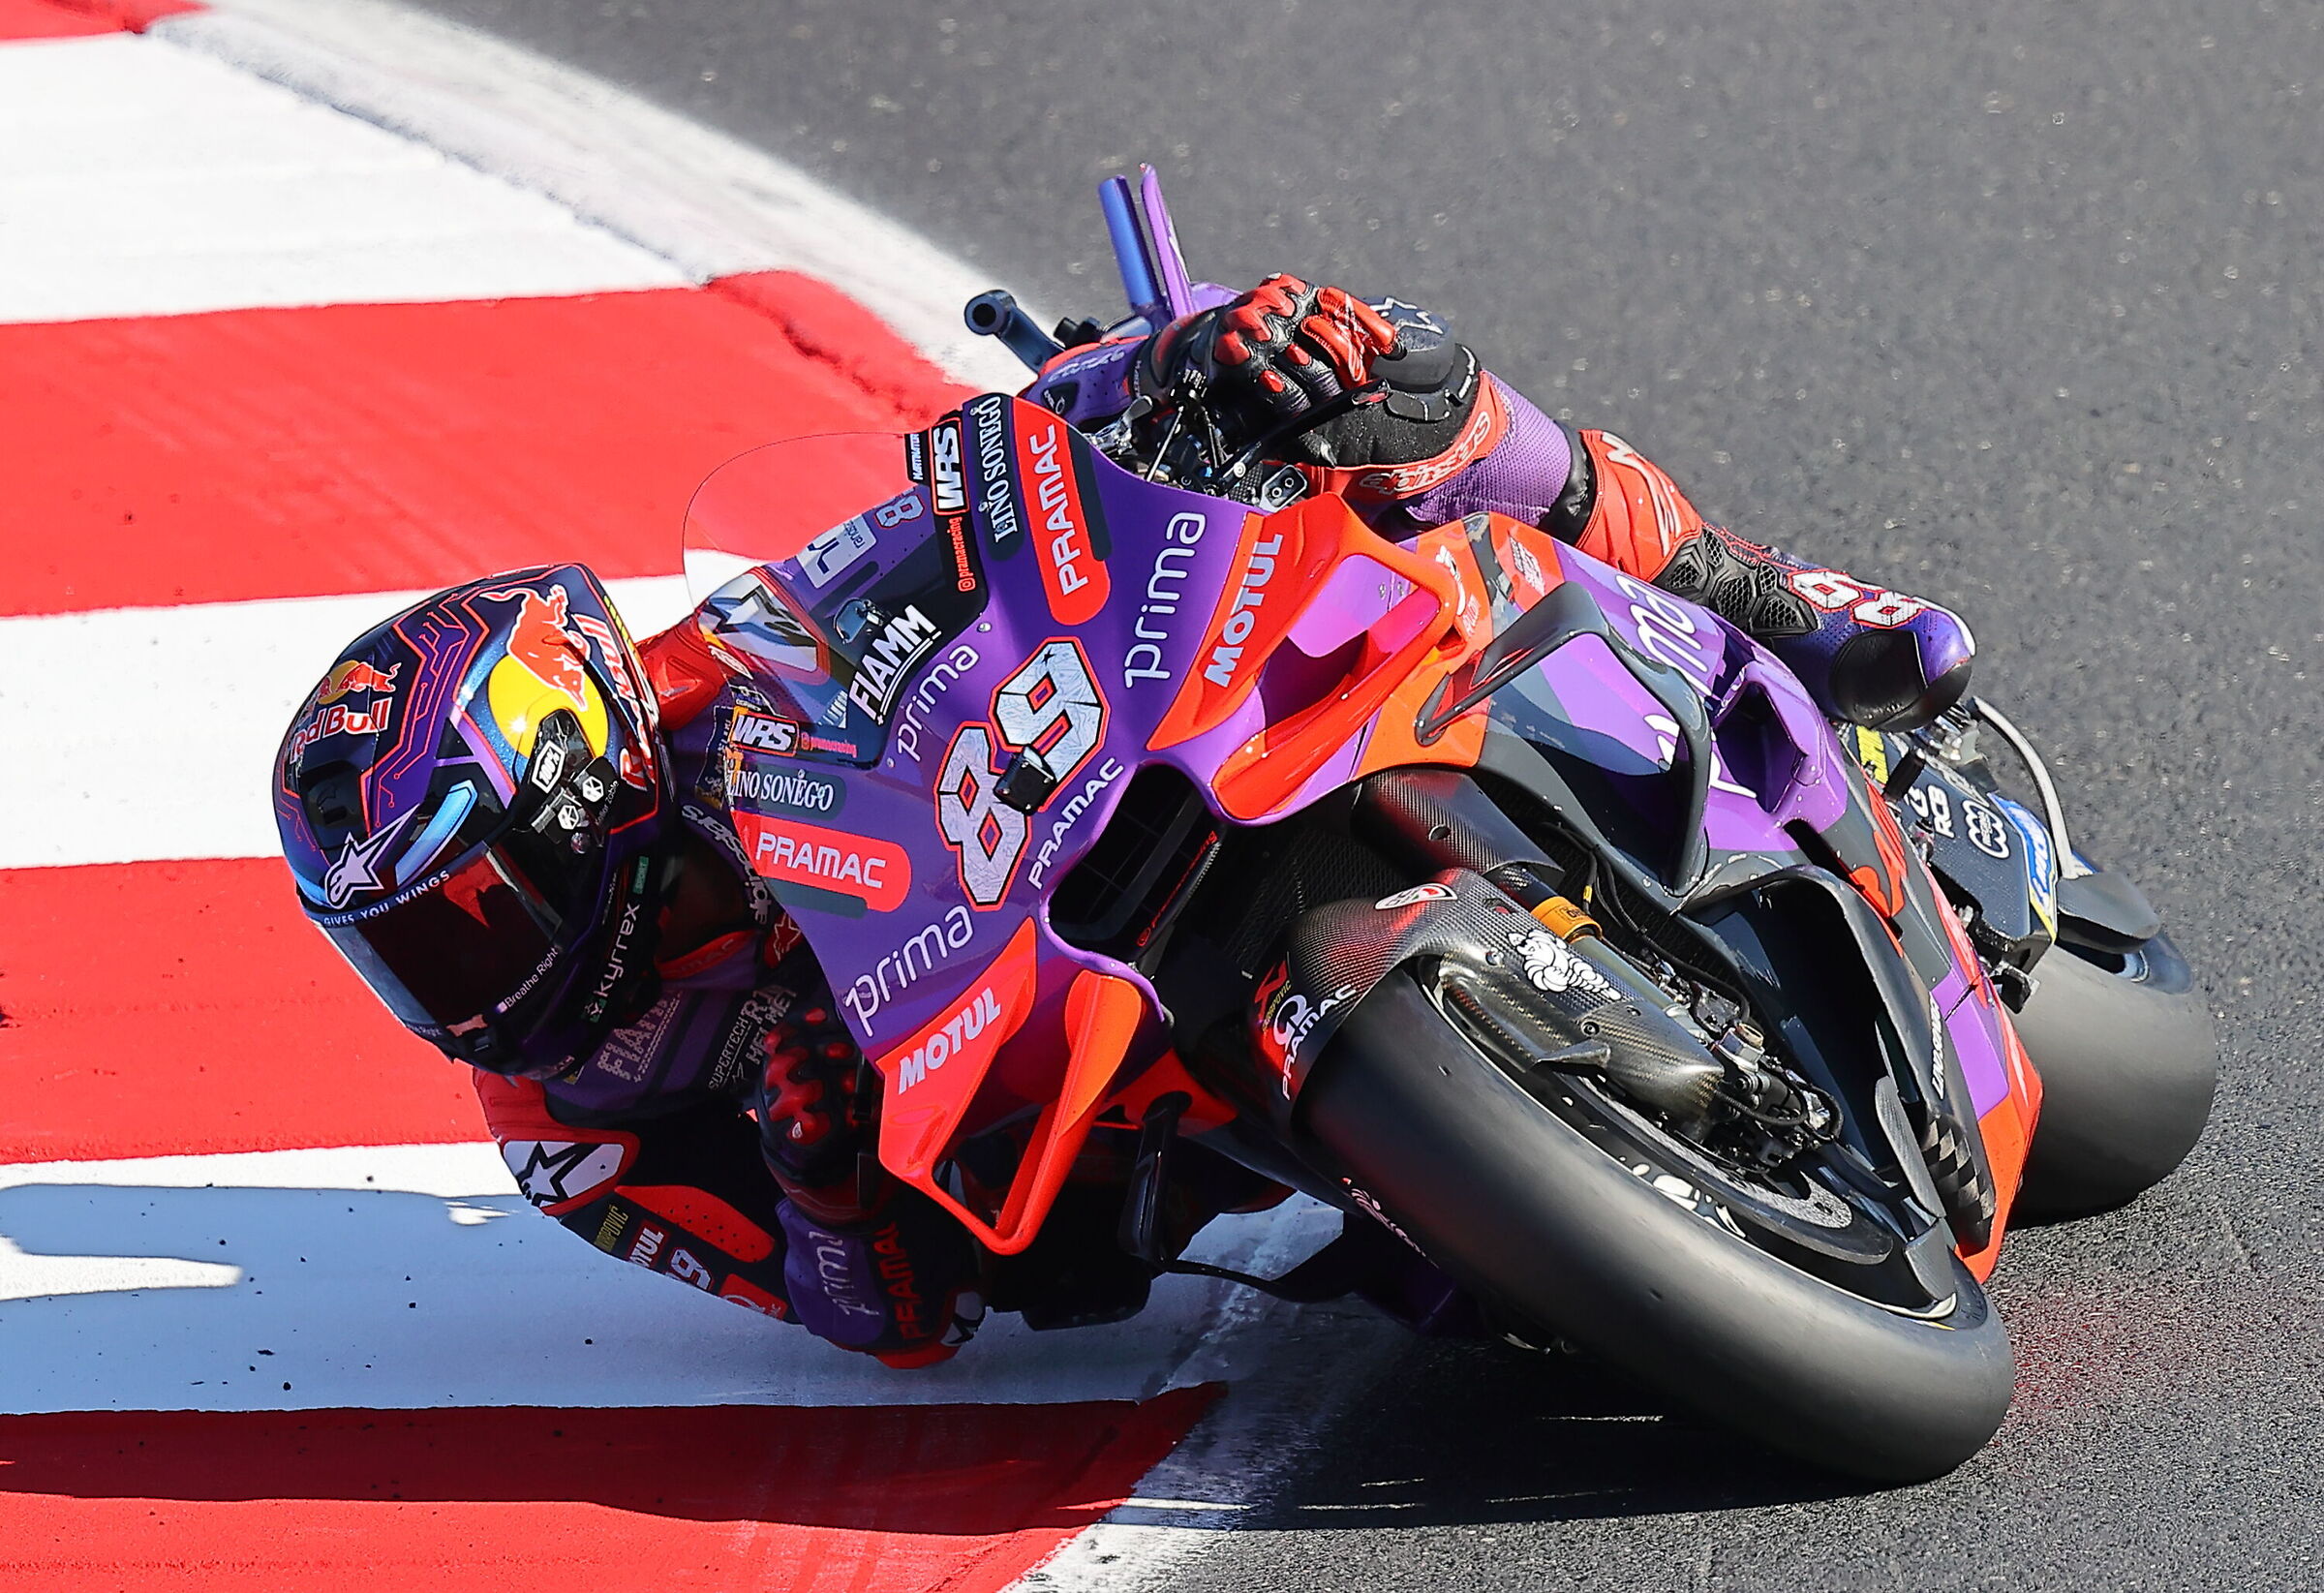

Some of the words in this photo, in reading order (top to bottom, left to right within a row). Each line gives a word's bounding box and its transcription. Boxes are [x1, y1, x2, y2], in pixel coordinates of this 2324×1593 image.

[933, 426, 965, 509] WRS
[978, 395, 1007, 481] SONEGO
[986, 479, 1018, 543] LINO
[1029, 424, 1089, 597] PRAMAC
[1124, 510, 1208, 689] prima
[1204, 534, 1284, 688] MOTUL
[848, 604, 938, 720] FIAMM
[897, 644, 980, 761] prima
[322, 696, 393, 739] Bull
[733, 714, 796, 751] WRS
[936, 639, 1106, 906] 89
[755, 833, 887, 889] PRAMAC
[1027, 757, 1124, 890] PRAMAC
[322, 913, 355, 926] GIVES
[359, 902, 389, 921] YOU
[395, 870, 451, 906] WINGS
[504, 972, 540, 1008] Breathe
[535, 946, 559, 977] Right
[843, 904, 974, 1037] prima
[708, 1008, 749, 1090] SUPERTECH
[898, 987, 1002, 1095] MOTUL
[1282, 983, 1357, 1101] PRAMAC
[629, 1227, 665, 1268] OTUL
